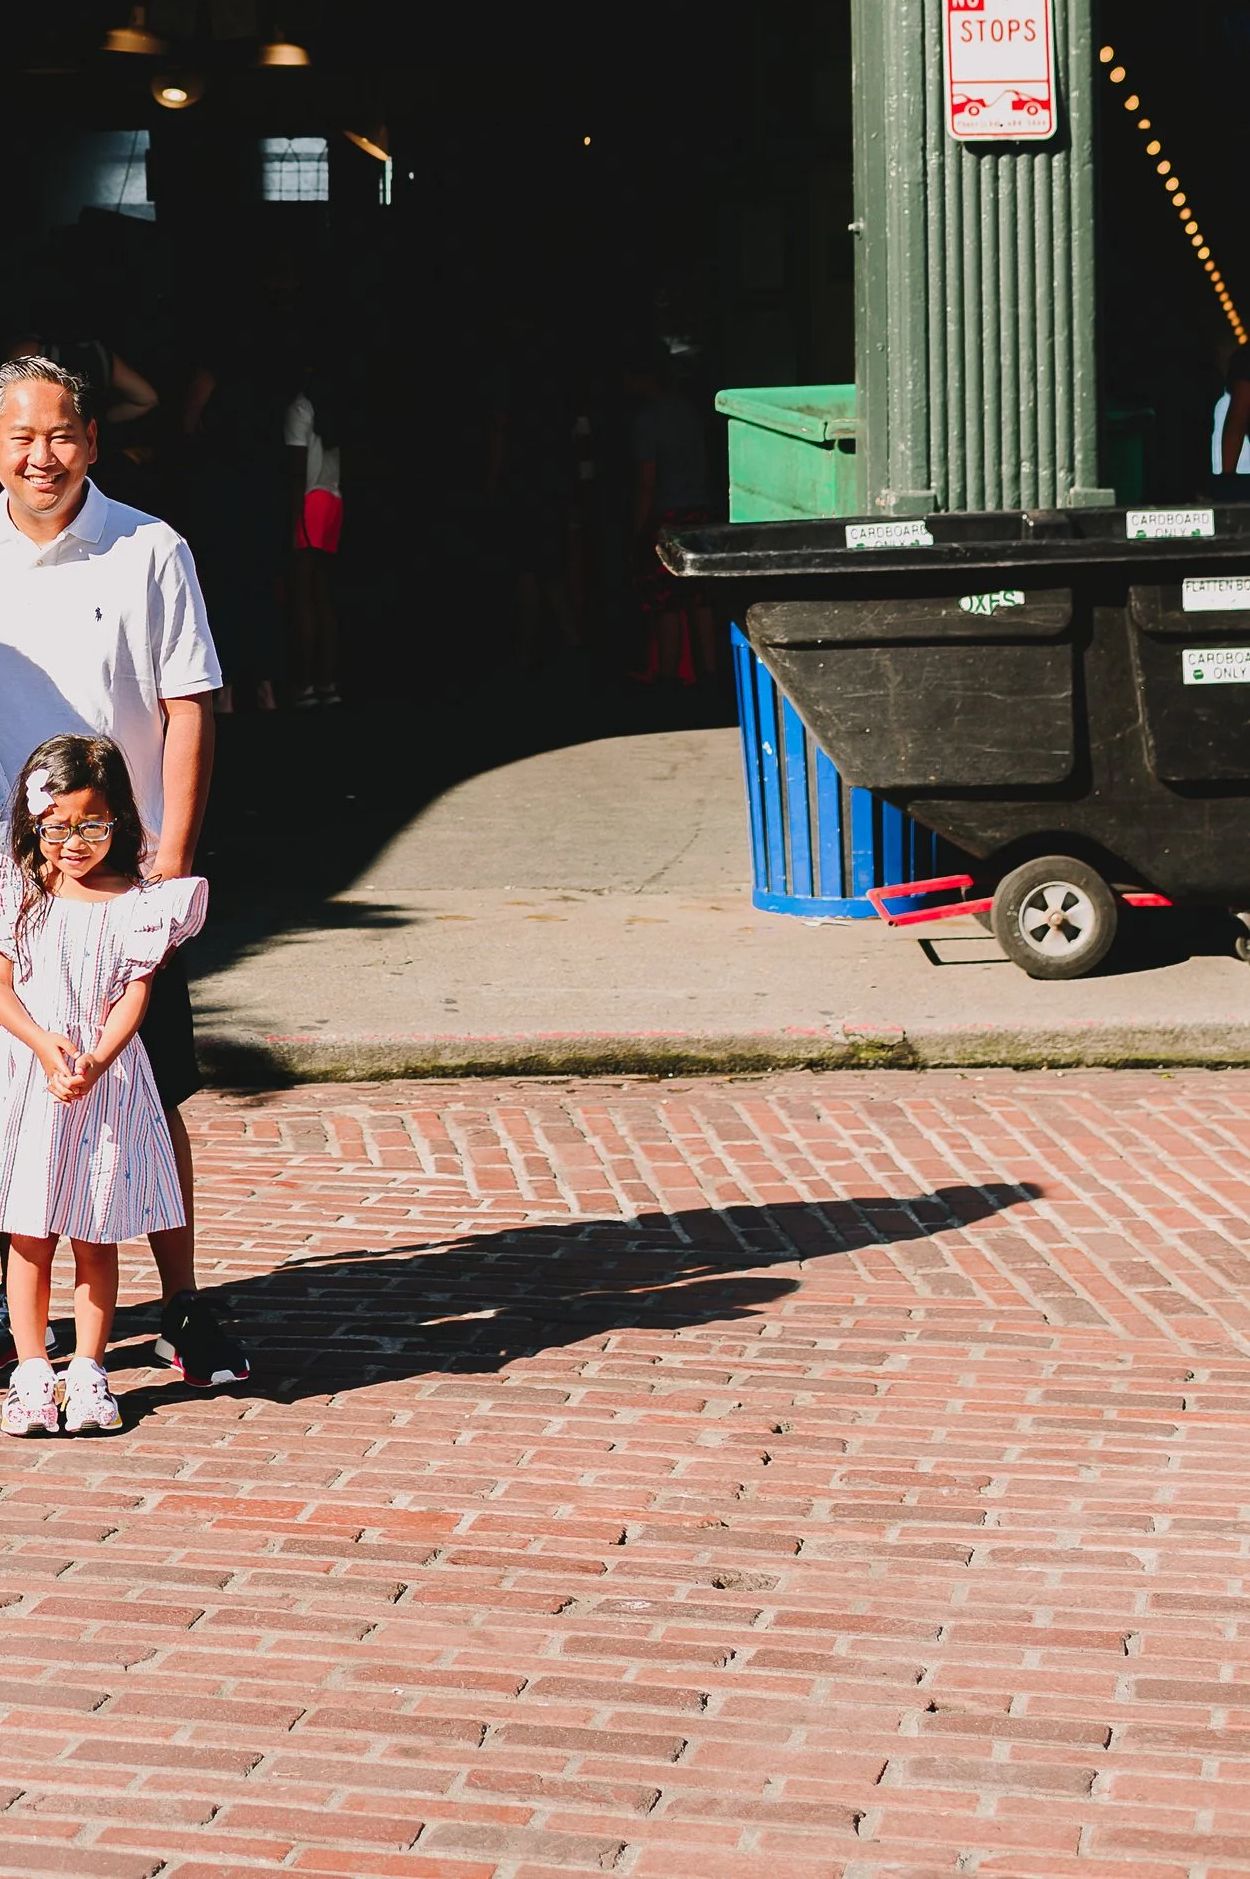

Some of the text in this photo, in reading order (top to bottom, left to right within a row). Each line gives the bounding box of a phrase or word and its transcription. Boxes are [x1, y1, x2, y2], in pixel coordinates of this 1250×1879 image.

[960, 18, 1037, 43] STOPS
[1132, 513, 1210, 526] CARDBOARD
[1213, 667, 1247, 680] ONLY
